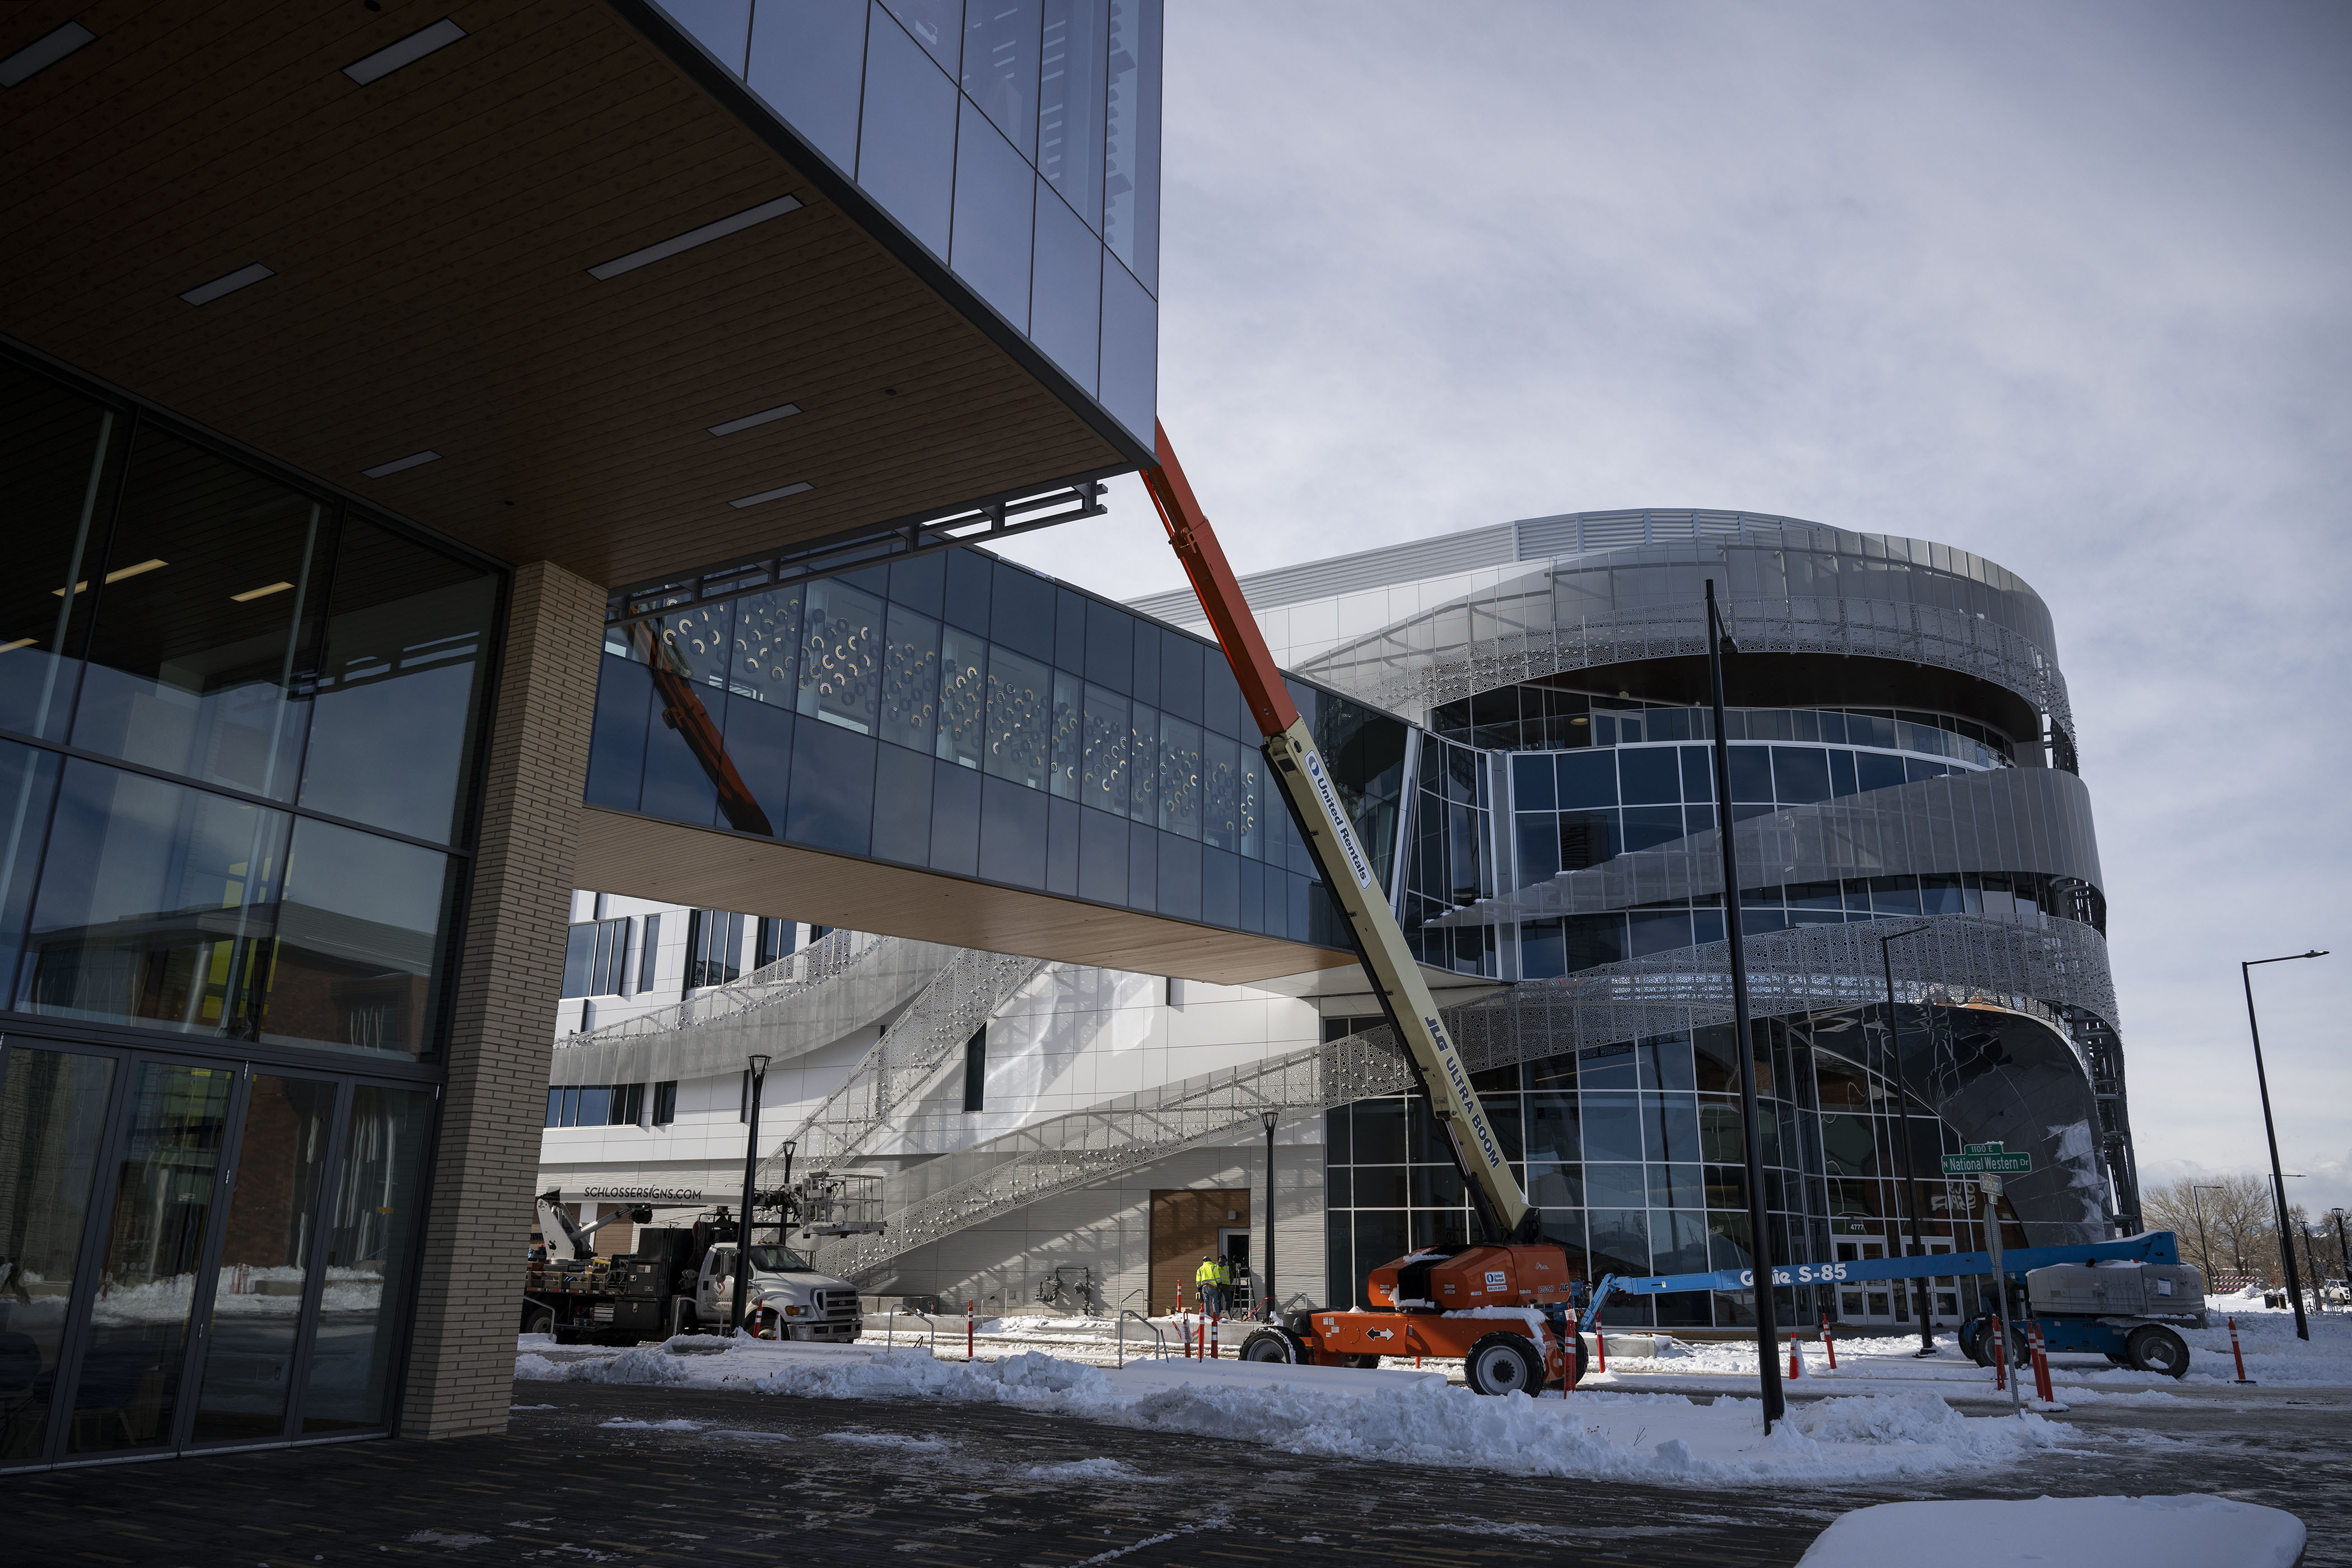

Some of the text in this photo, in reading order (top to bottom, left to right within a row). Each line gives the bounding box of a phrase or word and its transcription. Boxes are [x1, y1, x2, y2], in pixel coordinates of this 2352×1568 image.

[1317, 778, 1366, 881] United Rentals
[1424, 1016, 1501, 1169] JLG ULTRA BOOM
[1949, 1157, 1984, 1171] National
[1984, 1156, 2019, 1170] Western
[584, 1184, 702, 1200] SCHLOSSERSIGNS.COM
[1740, 1263, 1847, 1287] Gie S-85
[1559, 1283, 1569, 1292] JLG
